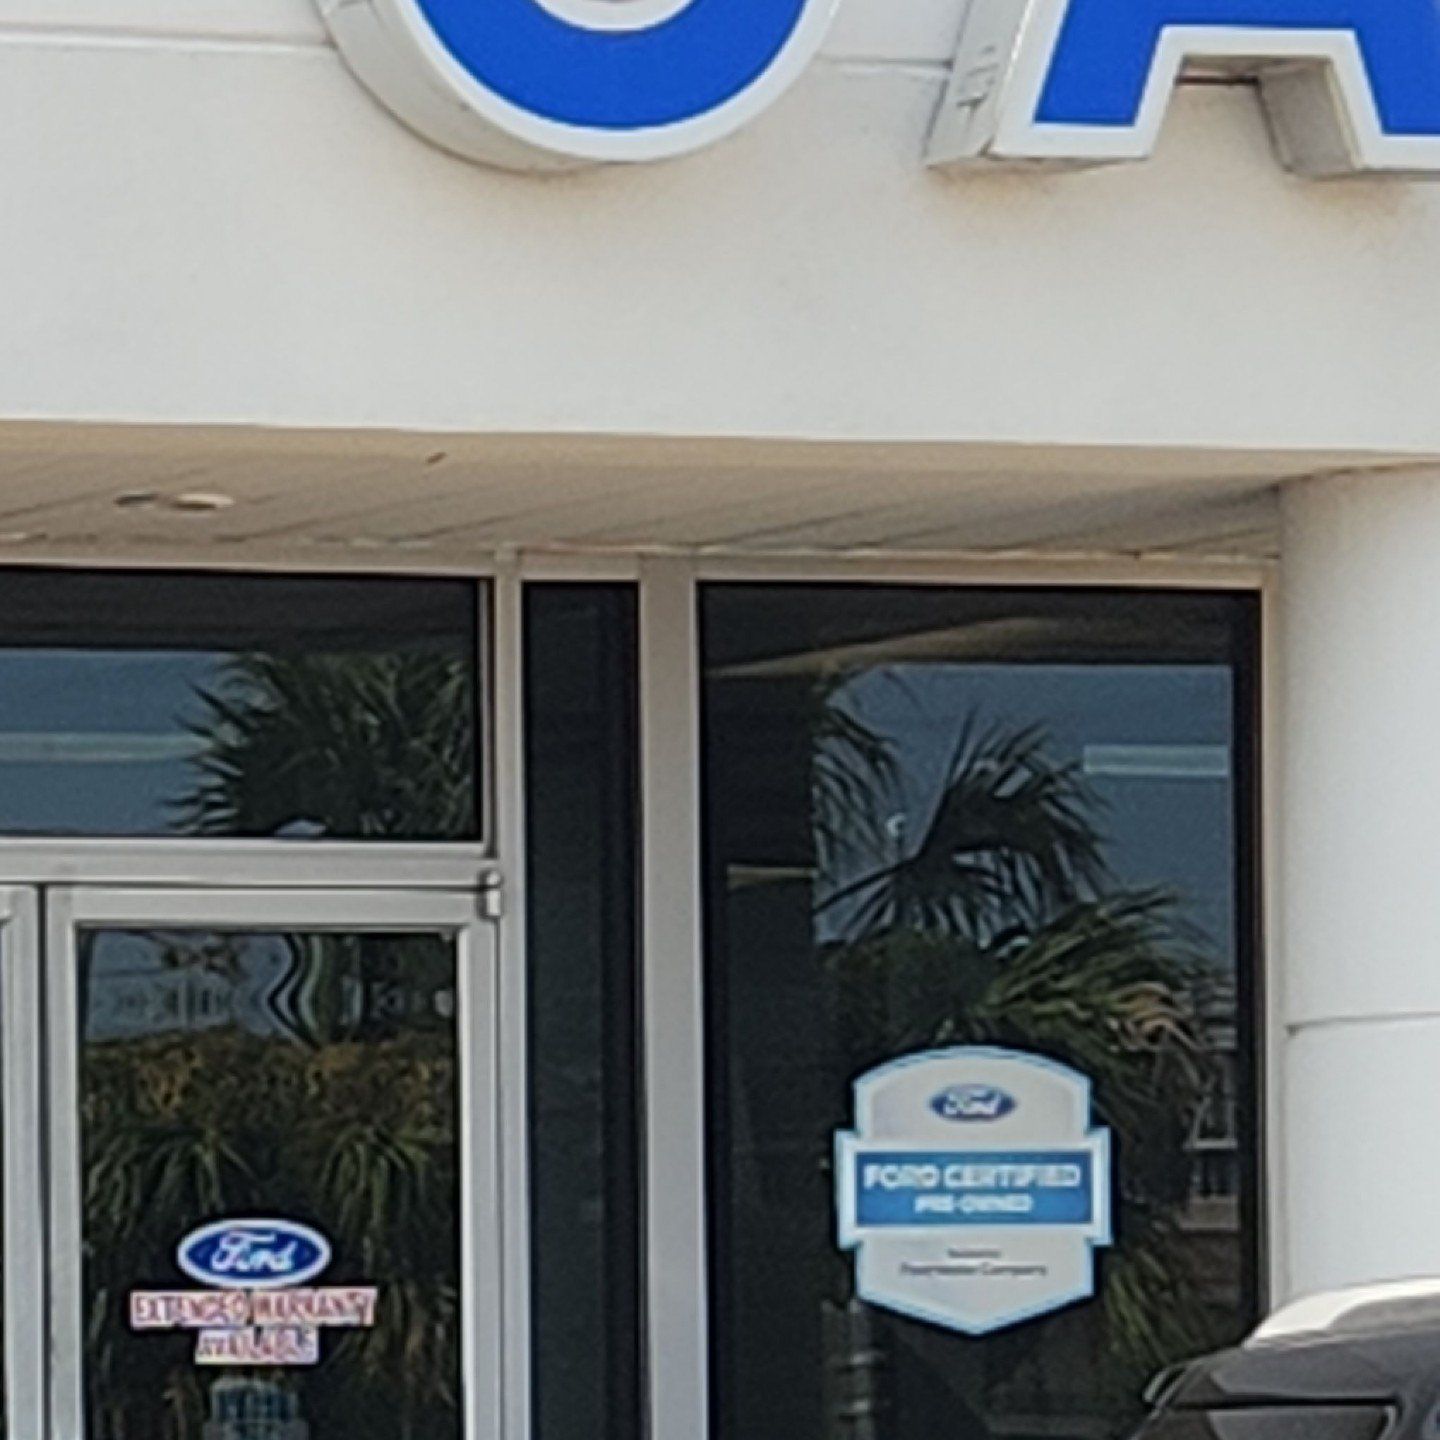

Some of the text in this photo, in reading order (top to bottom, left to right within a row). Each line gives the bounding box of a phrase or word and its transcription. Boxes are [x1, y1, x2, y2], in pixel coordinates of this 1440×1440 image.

[863, 1164, 1082, 1189] FORD CERTIFIED
[209, 1231, 297, 1272] Ford
